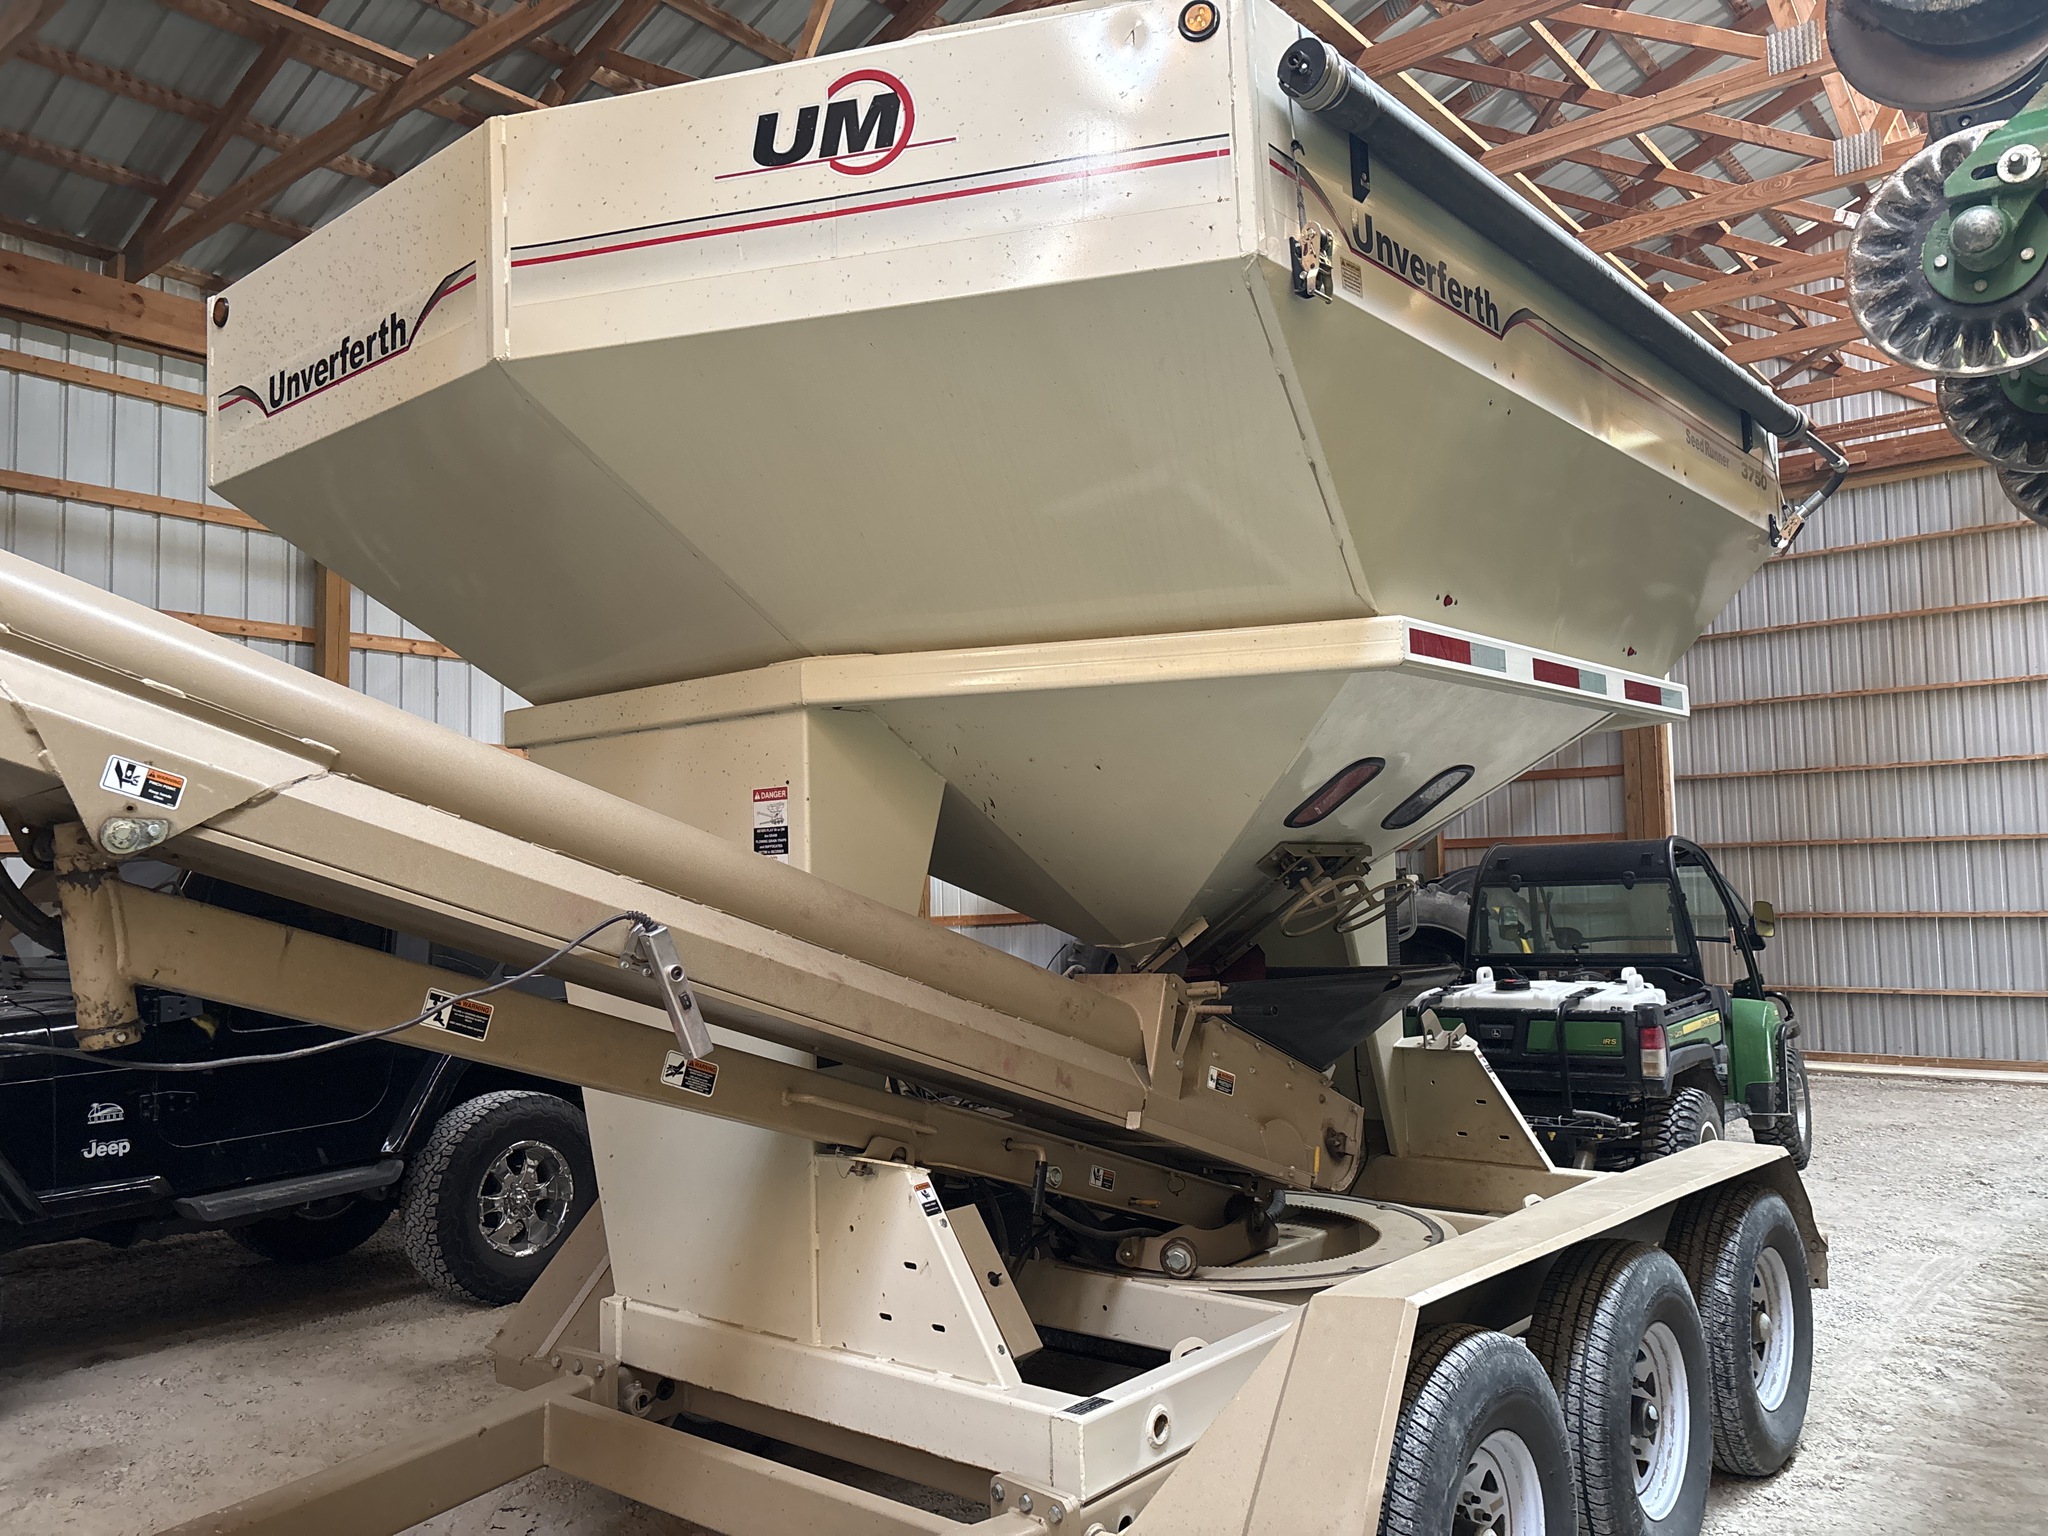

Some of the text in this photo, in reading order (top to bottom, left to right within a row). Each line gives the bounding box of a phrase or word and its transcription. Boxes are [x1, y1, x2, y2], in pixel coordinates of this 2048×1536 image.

[753, 92, 901, 167] UM
[1351, 206, 1499, 331] Unverferth
[269, 312, 407, 409] Unverferth
[1741, 462, 1768, 491] 3750
[156, 774, 181, 786] WARNING
[761, 790, 786, 799] DANGER
[463, 1001, 490, 1014] WARNING
[82, 1141, 131, 1159] Jeep
